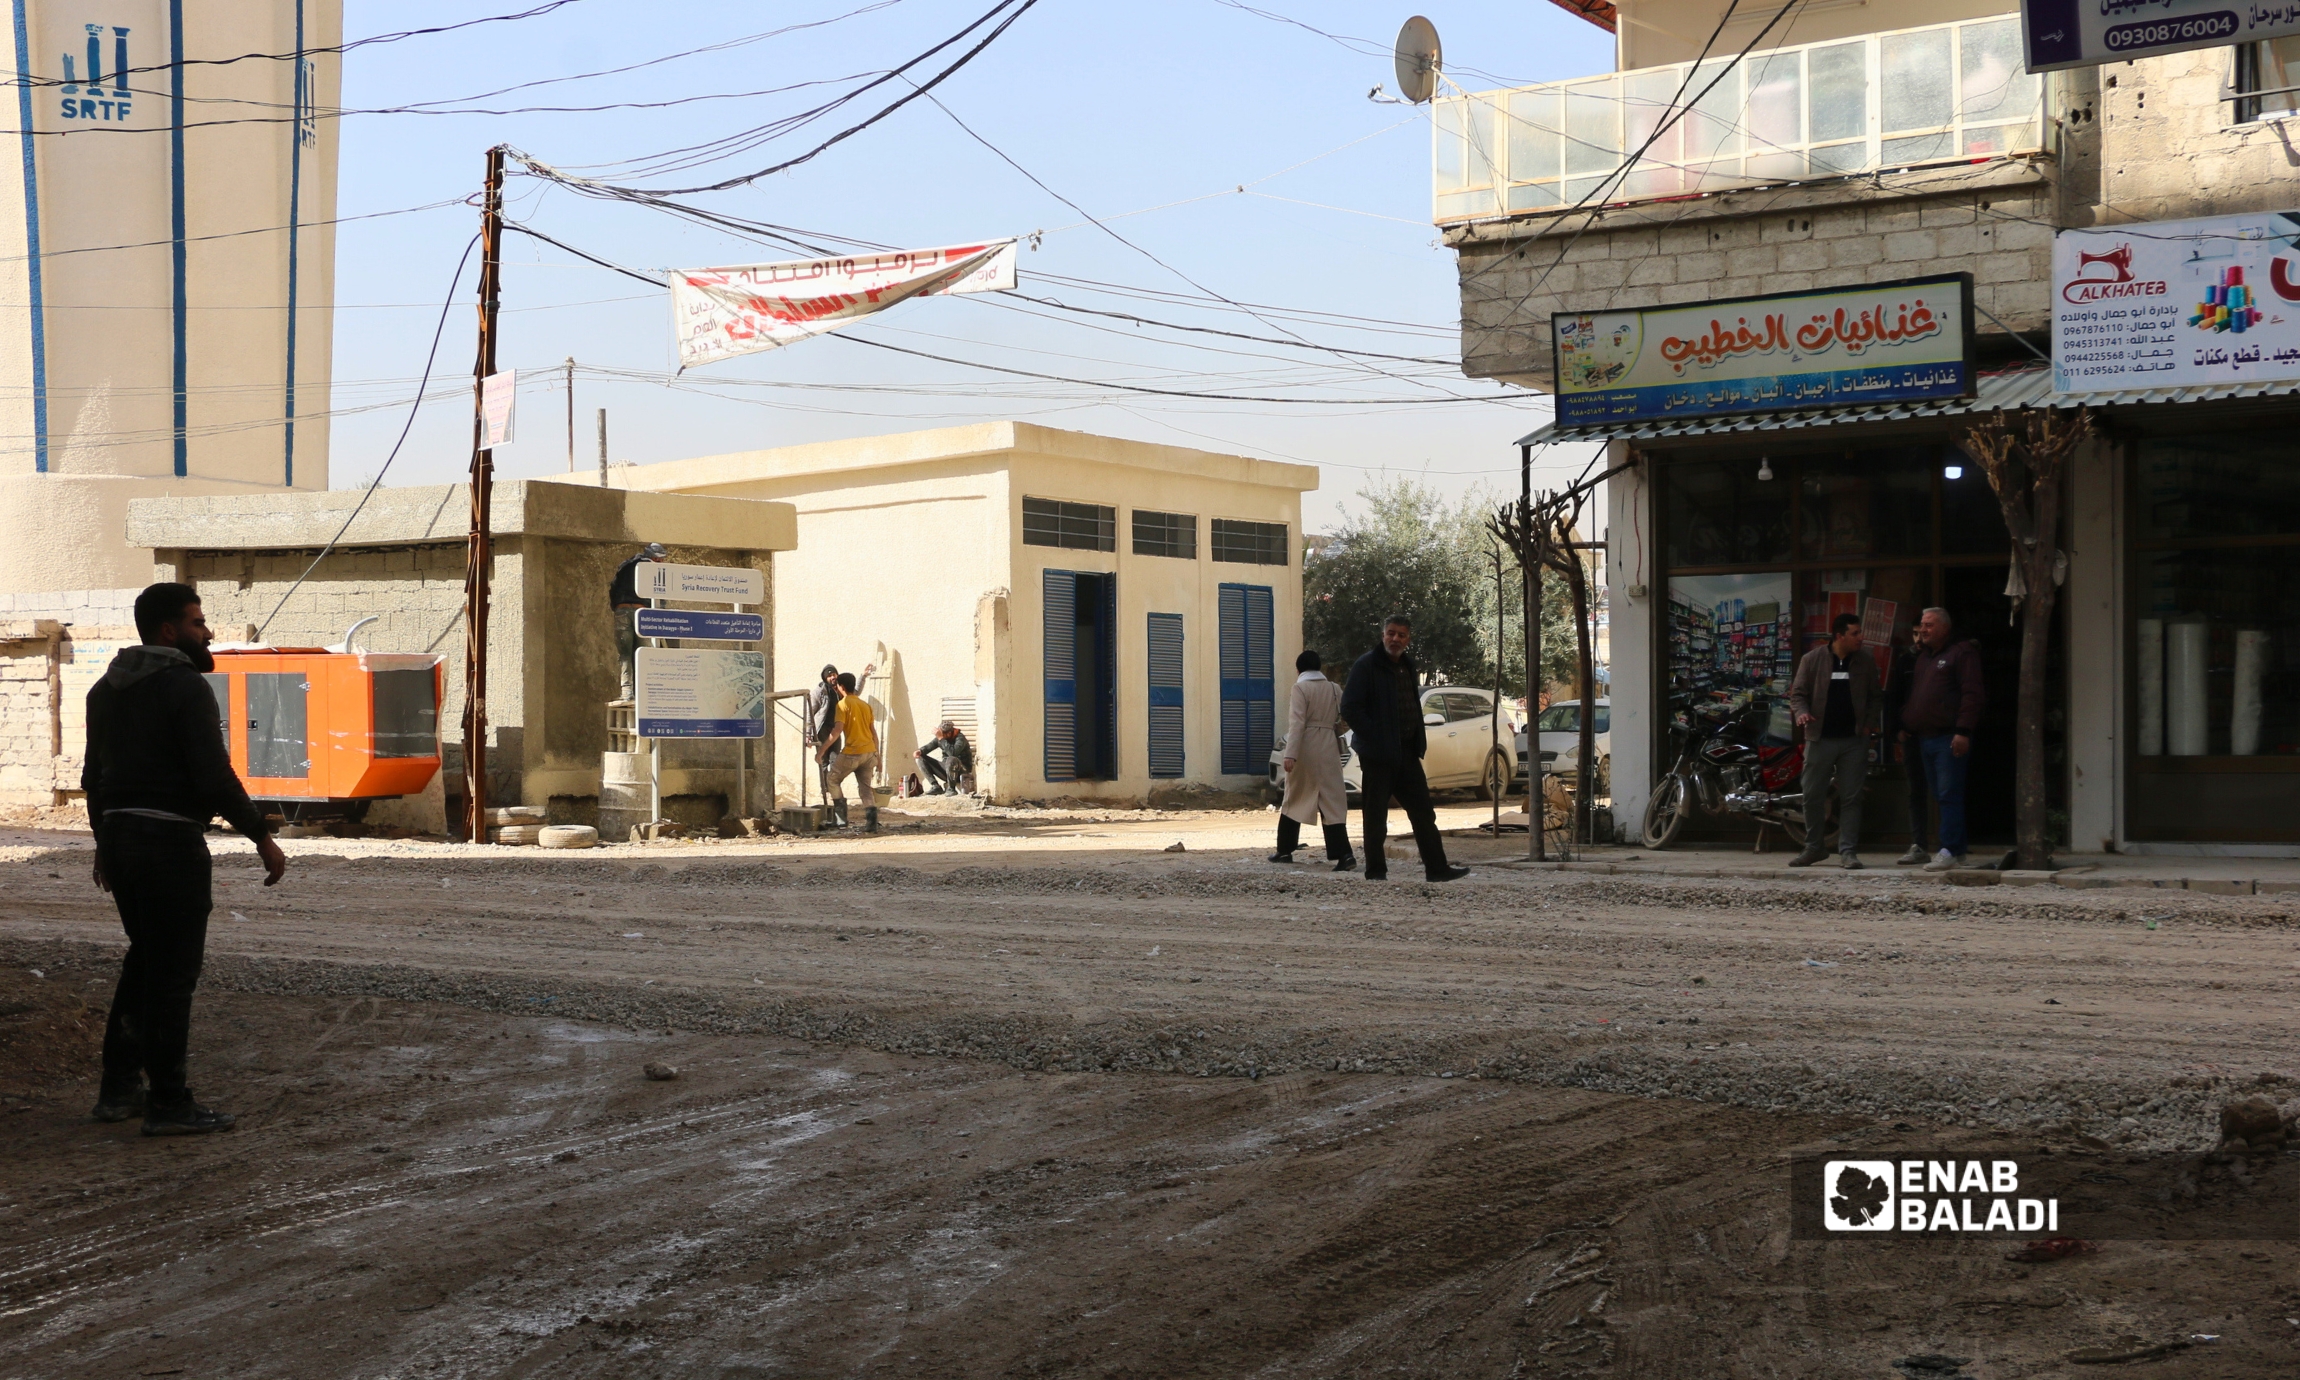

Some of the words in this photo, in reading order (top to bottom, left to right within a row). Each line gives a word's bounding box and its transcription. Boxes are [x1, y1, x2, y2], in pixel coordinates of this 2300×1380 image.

[2248, 3, 2282, 29] سرحان
[2108, 16, 2232, 47] 0930876004
[60, 97, 132, 121] SRTF
[299, 128, 316, 150] RTF
[2078, 280, 2168, 301] ALKHATEB
[2061, 310, 2098, 322] وأولاده
[2101, 309, 2127, 321] جمال
[2131, 306, 2146, 318] أبو
[2149, 306, 2178, 317] بإدارة
[1797, 298, 1938, 351] غذائيات
[2063, 323, 2123, 336] 0967876110
[2160, 318, 2175, 330] أبو
[1660, 313, 1790, 372] الخطيب
[2063, 337, 2122, 349] 0945313741
[2150, 334, 2175, 345] عبد
[2065, 351, 2124, 363] 0944225568
[2194, 347, 2229, 366] مكنات
[2232, 344, 2260, 370] قطع
[2273, 347, 2300, 365] جيد
[1902, 369, 1957, 390] غذائيات
[2063, 367, 2080, 377] 011
[2084, 365, 2125, 376] 6295624
[1751, 381, 1784, 404] ألبان
[1794, 379, 1832, 400] أجبان
[1842, 374, 1892, 393] منظفات
[1664, 391, 1696, 410] دخان
[1705, 389, 1741, 408] موالح
[682, 583, 695, 592] Syria
[696, 584, 720, 594] Recovery
